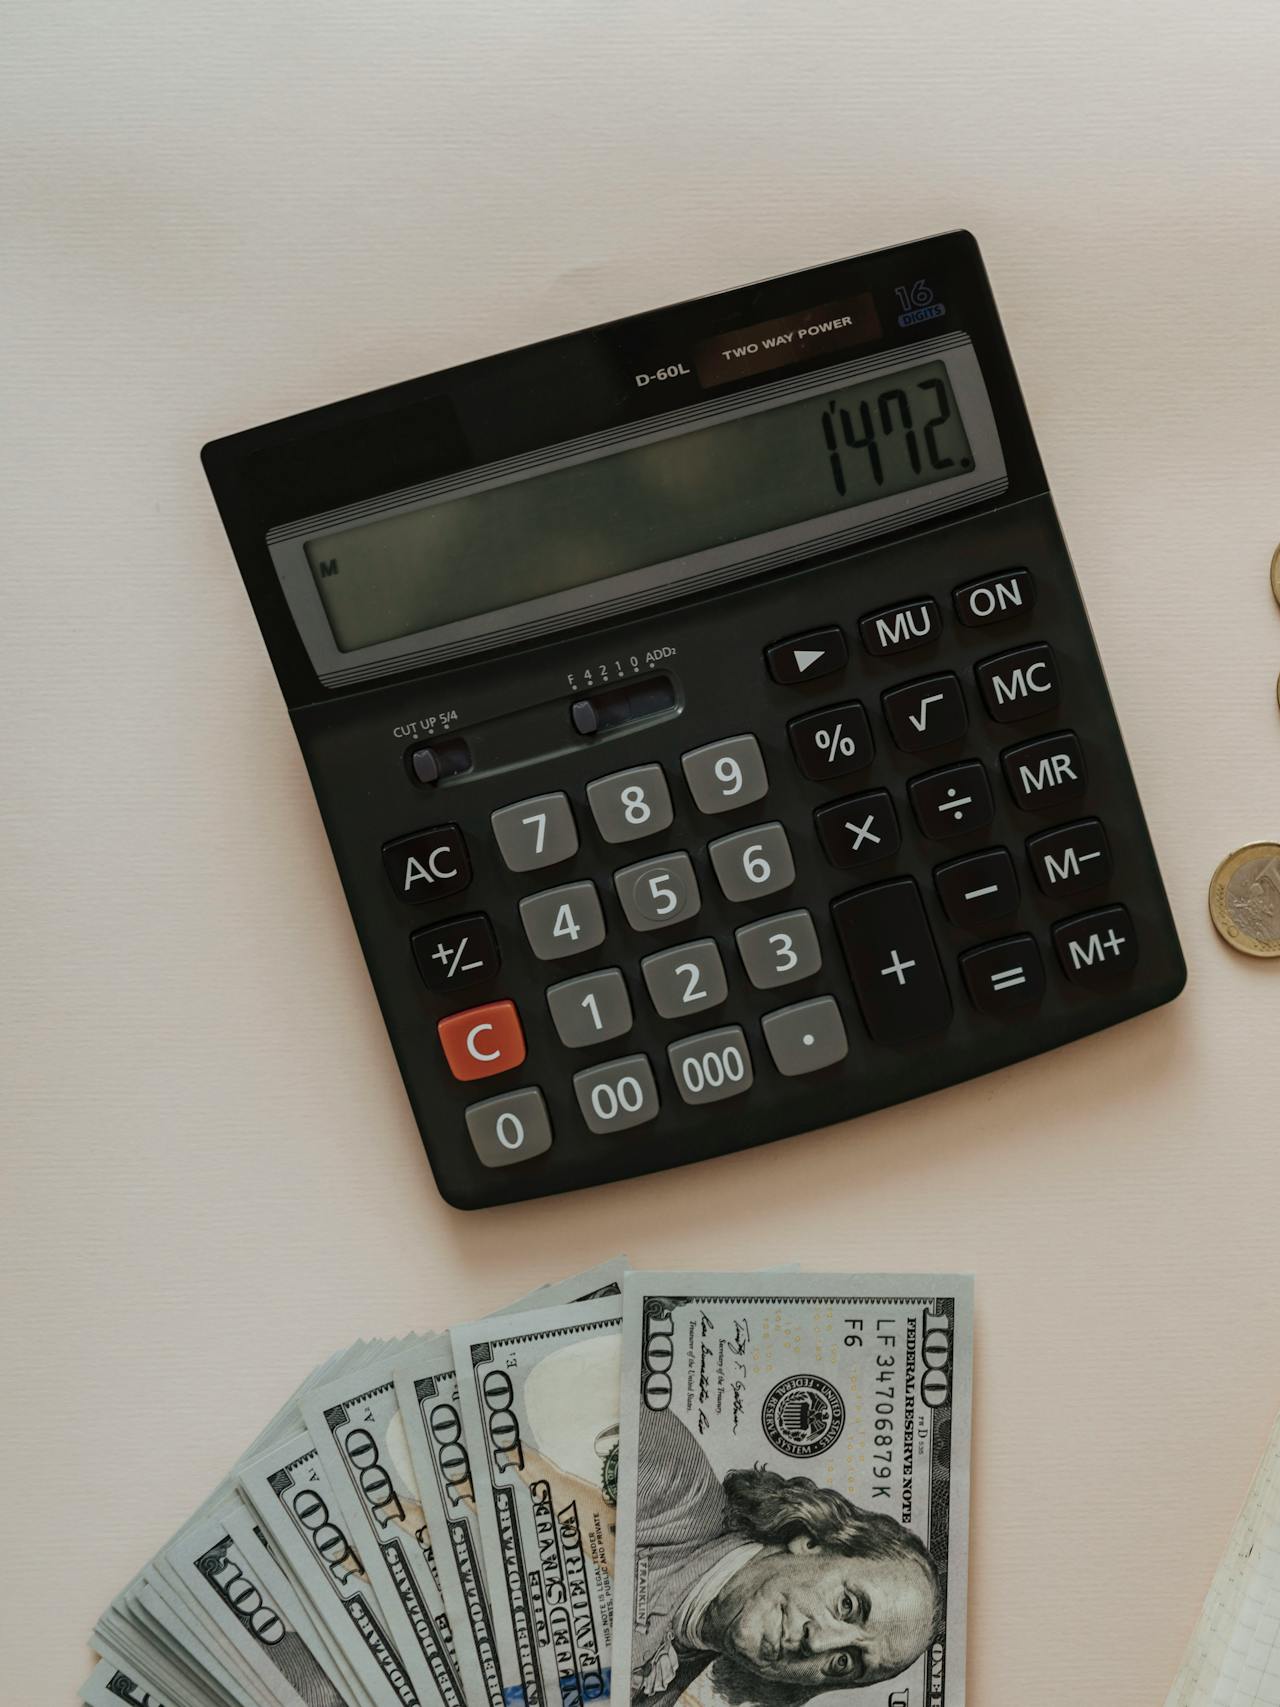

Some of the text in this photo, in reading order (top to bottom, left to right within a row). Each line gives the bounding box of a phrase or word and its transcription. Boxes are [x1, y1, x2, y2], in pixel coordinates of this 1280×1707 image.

[894, 279, 934, 311] 16
[902, 305, 941, 324] DIGITS
[722, 316, 852, 361] TWO WAY POWER
[635, 362, 690, 386] D-60L
[319, 558, 339, 579] M
[969, 578, 1023, 617] ON
[875, 605, 931, 647] MU
[583, 670, 592, 679] 4
[599, 665, 607, 675] 2
[991, 662, 1052, 705] MC
[392, 710, 458, 738] CUT UP 5/4
[814, 723, 856, 763] %
[714, 756, 743, 796] 9
[1019, 754, 1078, 794] MR
[620, 785, 651, 825] 8
[522, 813, 546, 854] 7
[404, 846, 458, 891] AC
[742, 844, 771, 883] 6
[648, 874, 678, 915] 5
[552, 903, 581, 941] 4
[768, 933, 798, 972] 3
[1068, 928, 1126, 970] M+
[674, 963, 707, 1003] 2
[581, 993, 603, 1030] 1
[466, 1023, 501, 1062] C
[682, 1046, 744, 1093] 000
[591, 1076, 644, 1120] 00
[496, 1112, 525, 1150] 0
[843, 1319, 862, 1346] F6
[643, 1312, 674, 1411] 100
[920, 1307, 949, 1408] 100
[480, 1367, 524, 1475] 100
[765, 1396, 778, 1436] RESERVE
[872, 1354, 894, 1478] 34706879
[901, 1318, 916, 1523] FEDERAL RESERVE NOTE
[429, 1403, 477, 1510] 100
[343, 1427, 407, 1530] 100
[291, 1488, 368, 1586] 100
[496, 1492, 524, 1607] DOLLARS
[556, 1500, 596, 1655] AMERICA
[638, 1562, 646, 1620] FRANKLIN
[215, 1555, 288, 1648] 100
